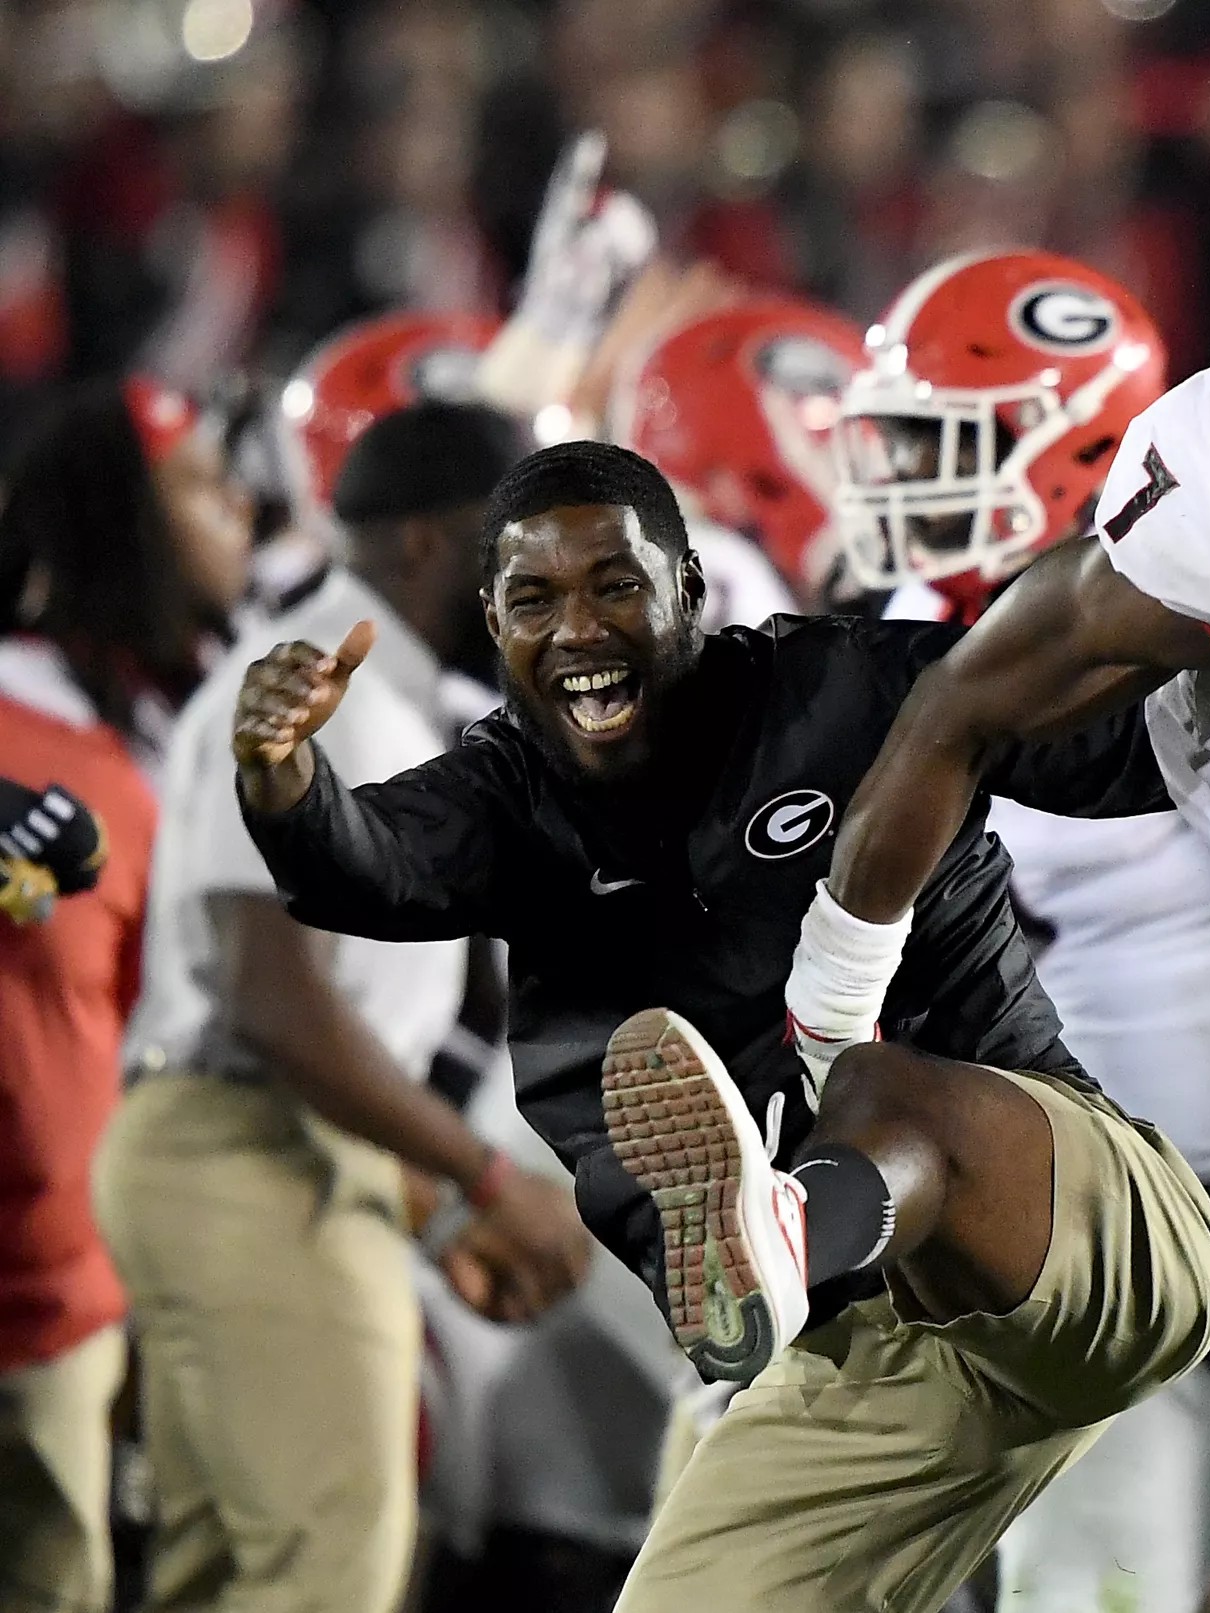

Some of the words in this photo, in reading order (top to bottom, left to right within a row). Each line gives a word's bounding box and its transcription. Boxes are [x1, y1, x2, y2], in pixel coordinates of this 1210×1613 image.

[1016, 283, 1116, 350] G
[1102, 441, 1181, 544] 7
[746, 790, 833, 858] G
